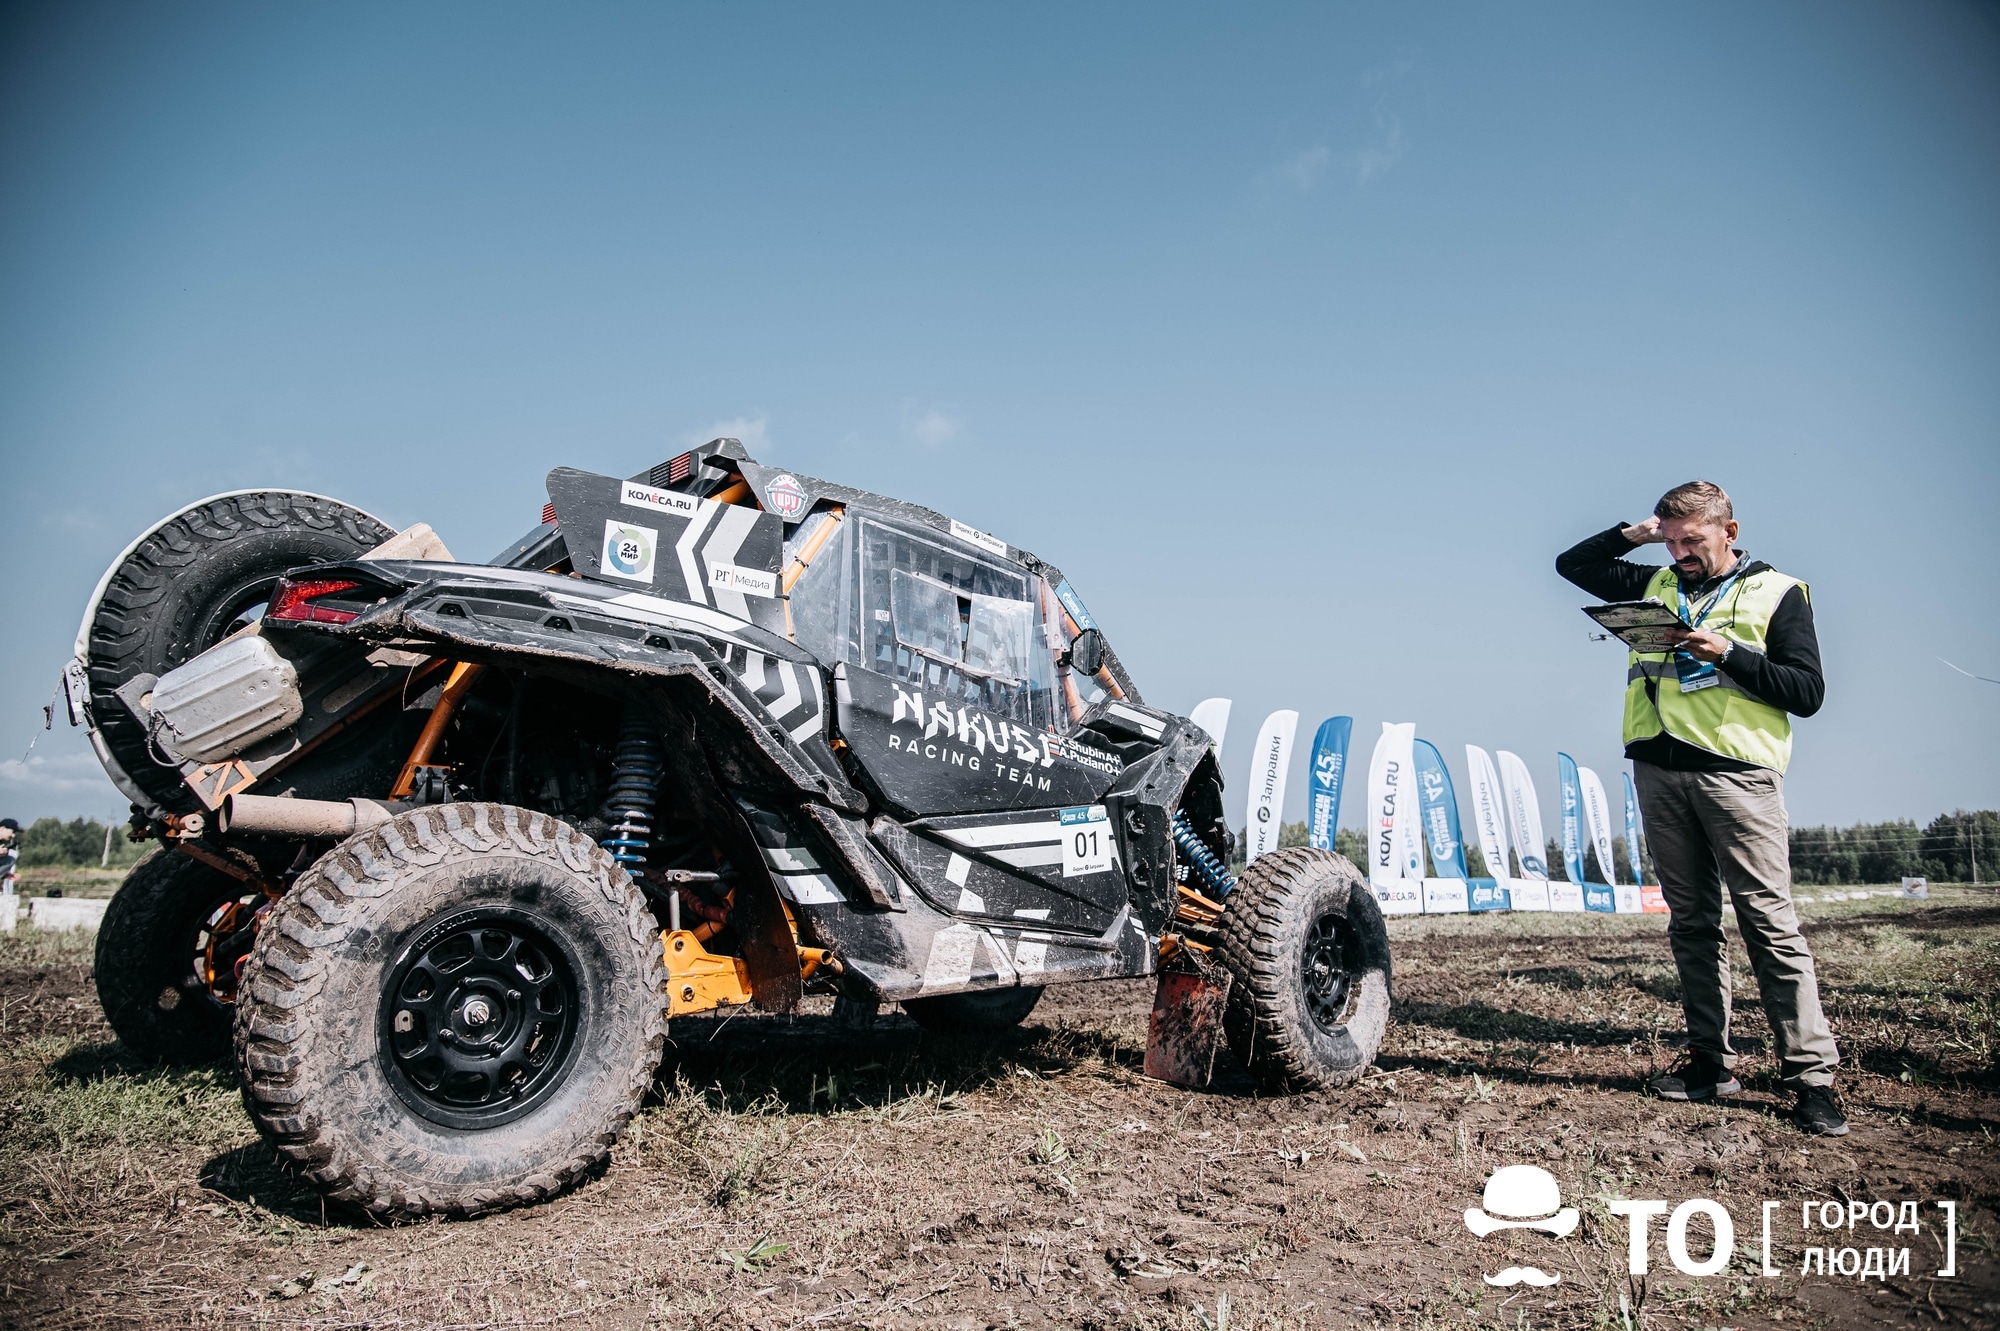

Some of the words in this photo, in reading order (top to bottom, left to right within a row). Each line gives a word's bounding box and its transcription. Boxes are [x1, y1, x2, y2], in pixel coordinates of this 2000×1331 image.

[620, 551, 639, 560] МИР
[623, 542, 638, 553] 24
[715, 569, 730, 582] РГ
[734, 574, 770, 590] Медиа
[888, 733, 981, 771] RACING
[995, 762, 1052, 792] TEAM
[1260, 735, 1281, 804] Заправки
[1316, 754, 1335, 788] 45
[1075, 830, 1098, 858] 01
